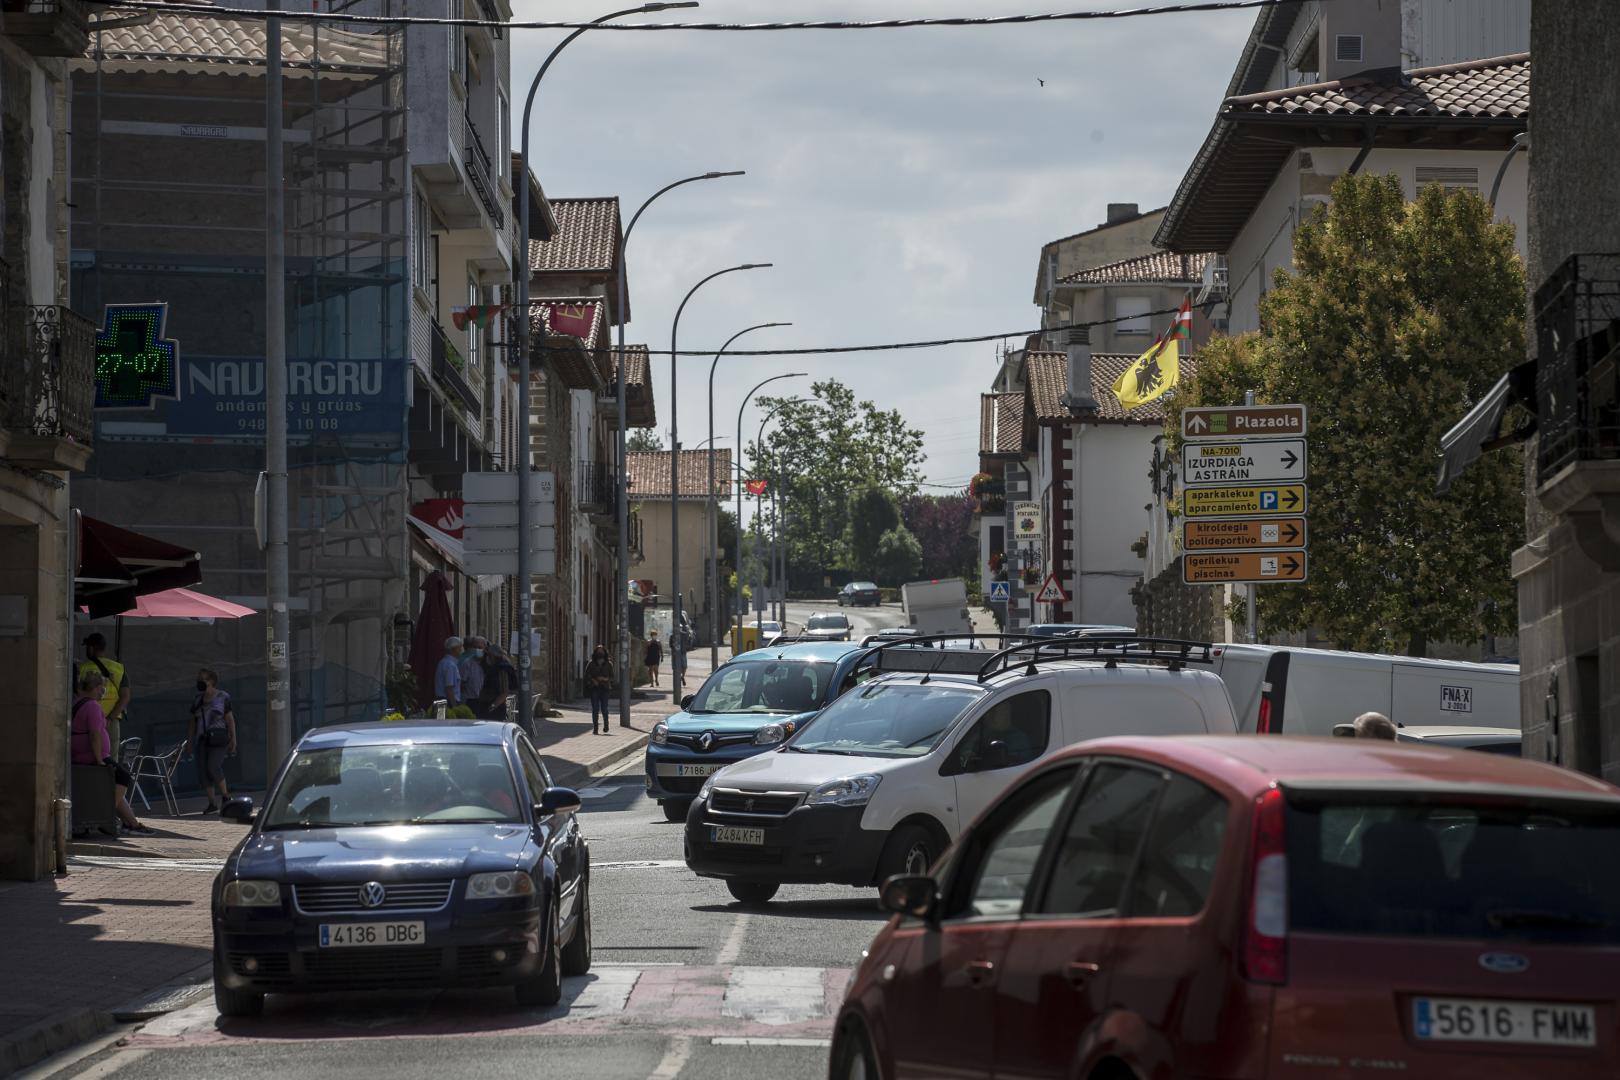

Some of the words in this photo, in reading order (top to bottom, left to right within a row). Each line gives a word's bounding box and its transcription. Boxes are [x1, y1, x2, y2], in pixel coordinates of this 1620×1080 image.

[96, 353, 160, 374] 27-07
[188, 361, 382, 396] NAVRGRU
[215, 400, 294, 412] andams
[301, 401, 310, 415] y
[317, 400, 362, 415] grúas
[238, 418, 265, 430] 948
[297, 418, 313, 430] 10
[320, 418, 338, 430] 08
[1235, 414, 1299, 429] Plazaola
[1202, 446, 1240, 456] NA-7010
[1188, 457, 1254, 468] IZURDIAGA
[1194, 467, 1249, 480] ASTRÁIN
[1191, 489, 1254, 500] aparkalekua
[1189, 502, 1258, 514] aparcamiento
[1197, 523, 1248, 533] kiroldegia
[1189, 536, 1257, 547] polideportivo
[1189, 556, 1240, 566] igerilekua
[1194, 569, 1235, 579] piscinas
[1443, 688, 1469, 703] FNA-X
[684, 766, 705, 775] 7186
[717, 827, 740, 841] 2484
[743, 829, 762, 842] KFH
[333, 926, 376, 943] 4136
[386, 925, 418, 942] DBG
[1436, 1004, 1512, 1037] 5616
[1532, 1008, 1590, 1040] FMM
